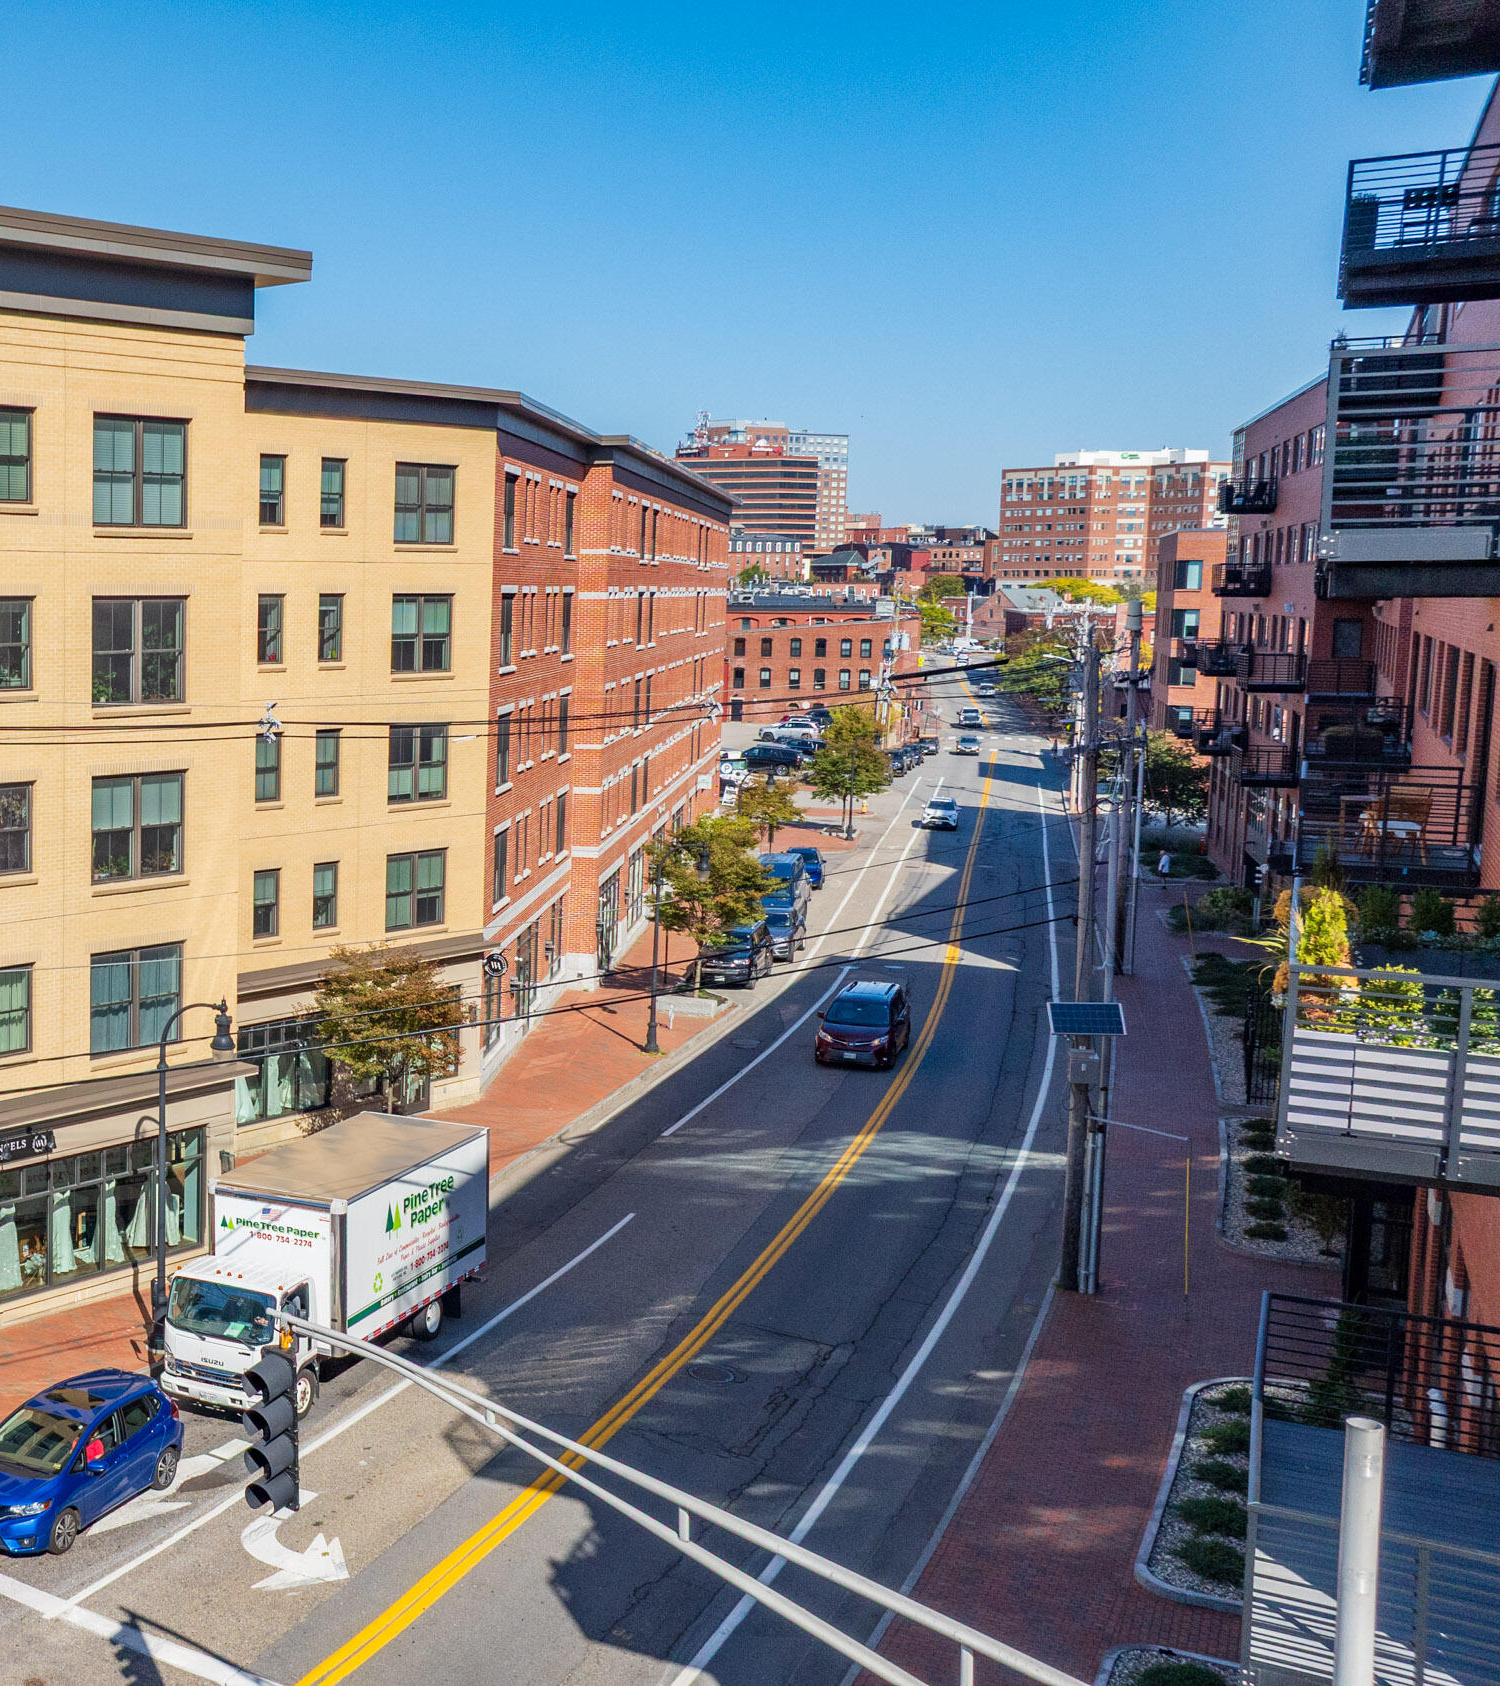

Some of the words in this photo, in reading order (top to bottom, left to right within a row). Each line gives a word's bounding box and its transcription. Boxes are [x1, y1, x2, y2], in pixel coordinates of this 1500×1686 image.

[403, 1189, 429, 1214] Pine
[429, 1175, 454, 1199] Tree
[410, 1197, 445, 1228] Paper
[235, 1217, 260, 1229] Pine
[260, 1221, 285, 1233] Tree
[286, 1226, 320, 1239] Paper
[201, 1357, 224, 1367] ISUZU
